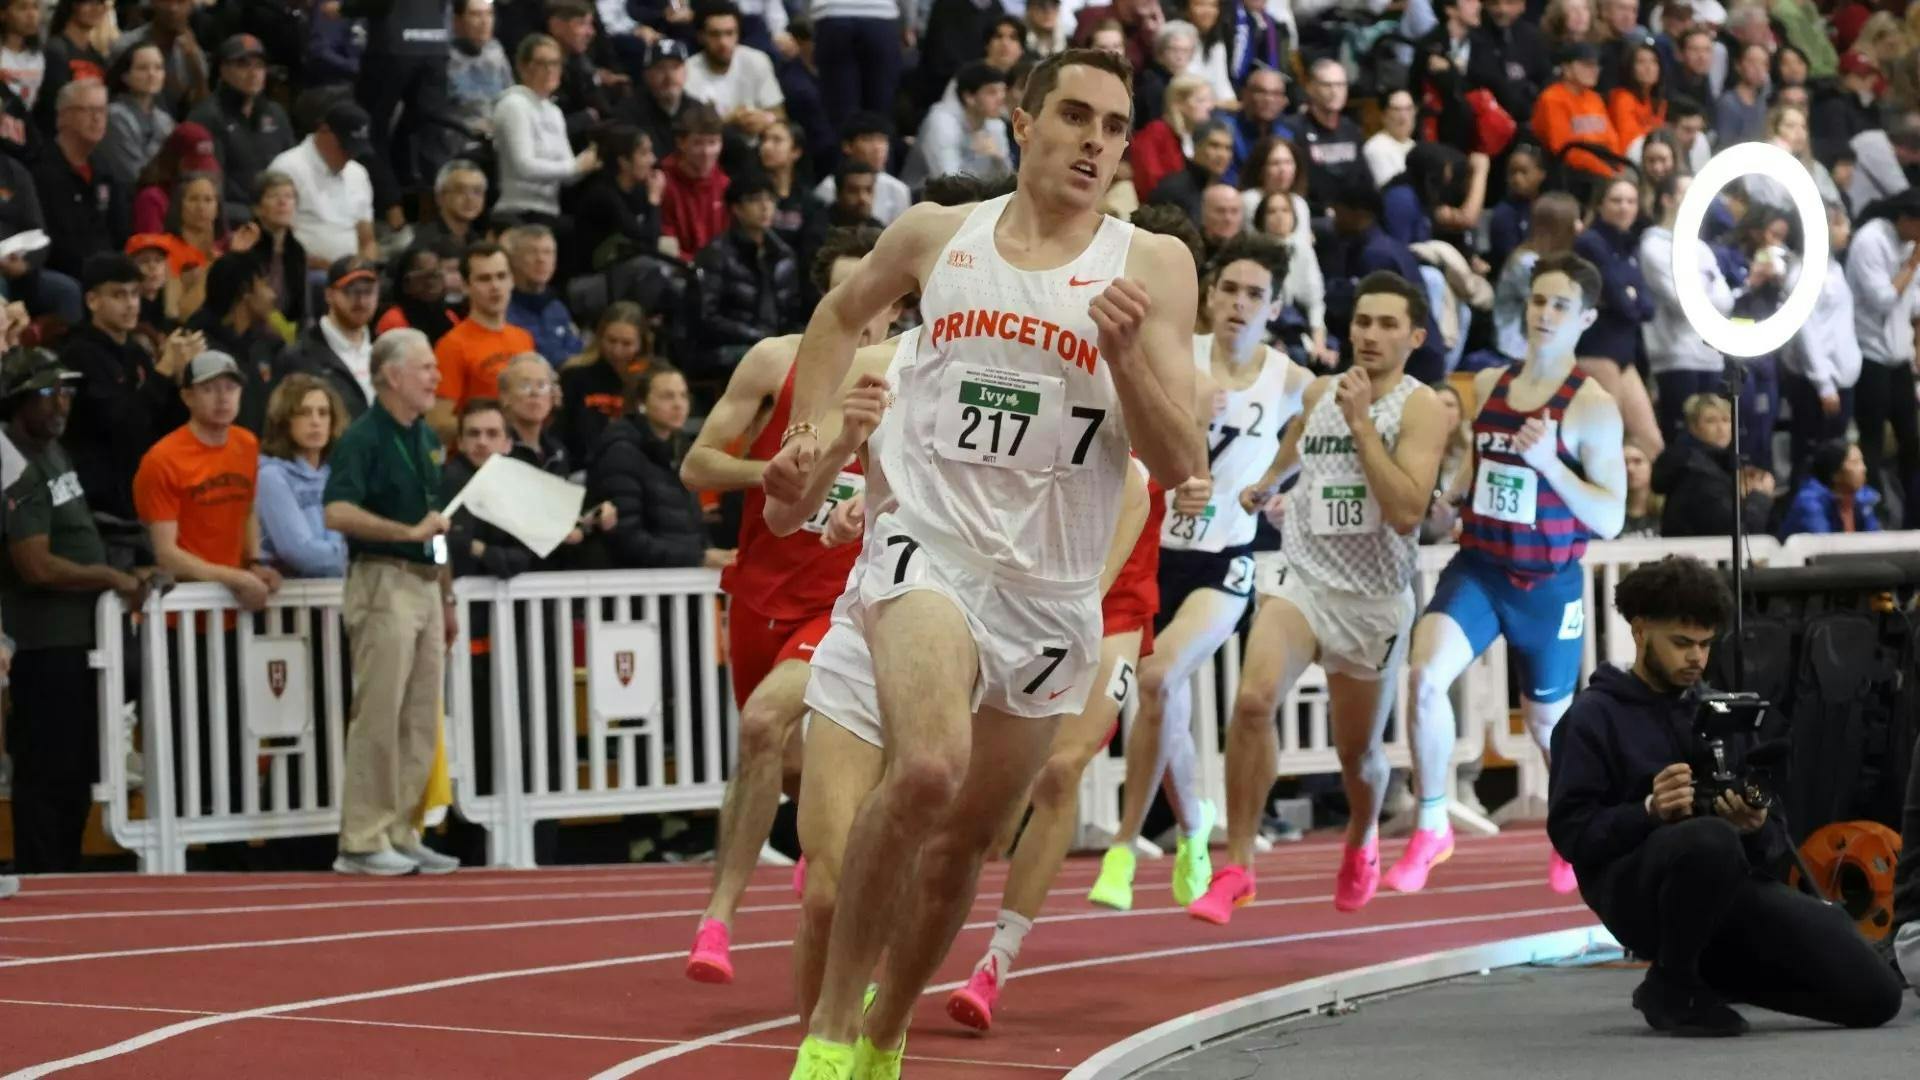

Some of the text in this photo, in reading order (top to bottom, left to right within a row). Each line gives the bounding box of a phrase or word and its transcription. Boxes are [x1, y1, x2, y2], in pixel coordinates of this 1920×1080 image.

[931, 309, 1100, 376] PRINCETON
[979, 386, 1007, 408] Ivy
[957, 405, 1031, 457] 217
[1071, 405, 1107, 465] 7
[1246, 402, 1264, 437] 2
[1326, 500, 1363, 527] 103
[1488, 486, 1520, 514] 153
[1169, 512, 1212, 542] 237
[887, 534, 920, 585] 7
[1231, 559, 1249, 589] 2
[1275, 566, 1288, 586] 1
[1022, 646, 1069, 695] 7
[1112, 662, 1134, 702] 5
